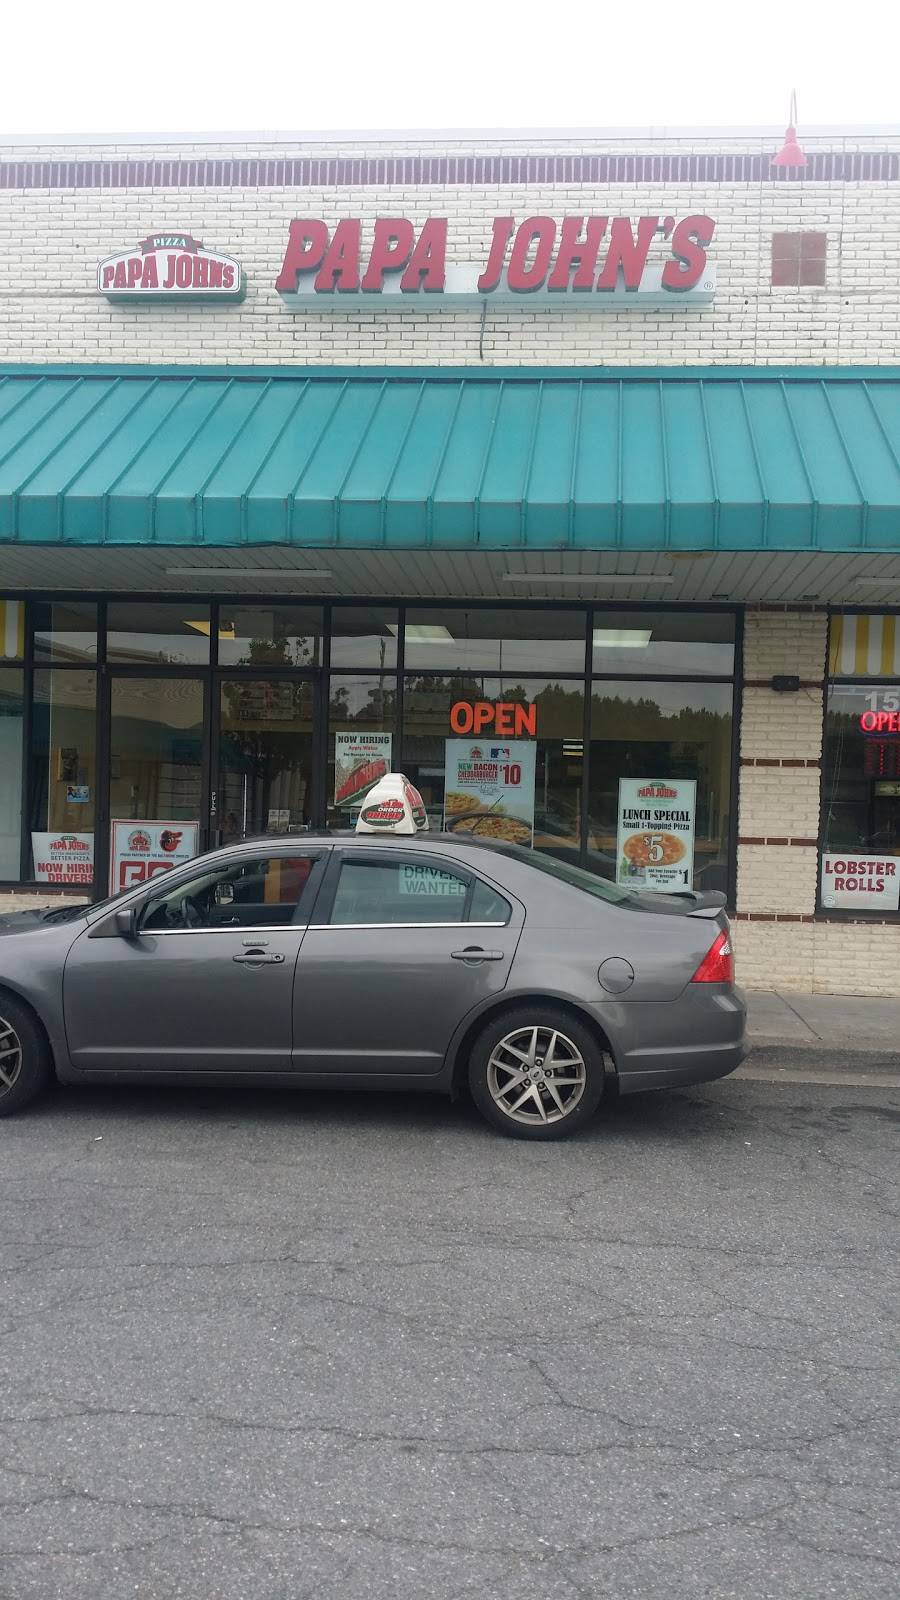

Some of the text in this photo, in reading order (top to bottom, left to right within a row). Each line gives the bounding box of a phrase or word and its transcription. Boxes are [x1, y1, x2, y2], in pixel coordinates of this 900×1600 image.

[153, 238, 186, 247] PIZZA
[275, 215, 716, 292] PAPA JOHN'S
[102, 254, 159, 289] PAPA
[450, 701, 537, 736] OPEN
[861, 711, 900, 732] OPE
[360, 736, 390, 744] HIRING
[623, 809, 691, 822] LUNCH SPECIAL
[641, 822, 672, 831] 1-Topping
[674, 823, 690, 831] Pizza
[642, 834, 664, 863] $5
[37, 862, 63, 873] NOW
[825, 860, 897, 876] LOBSTER
[48, 873, 94, 884] DRIVERS
[835, 877, 885, 893] ROLLS
